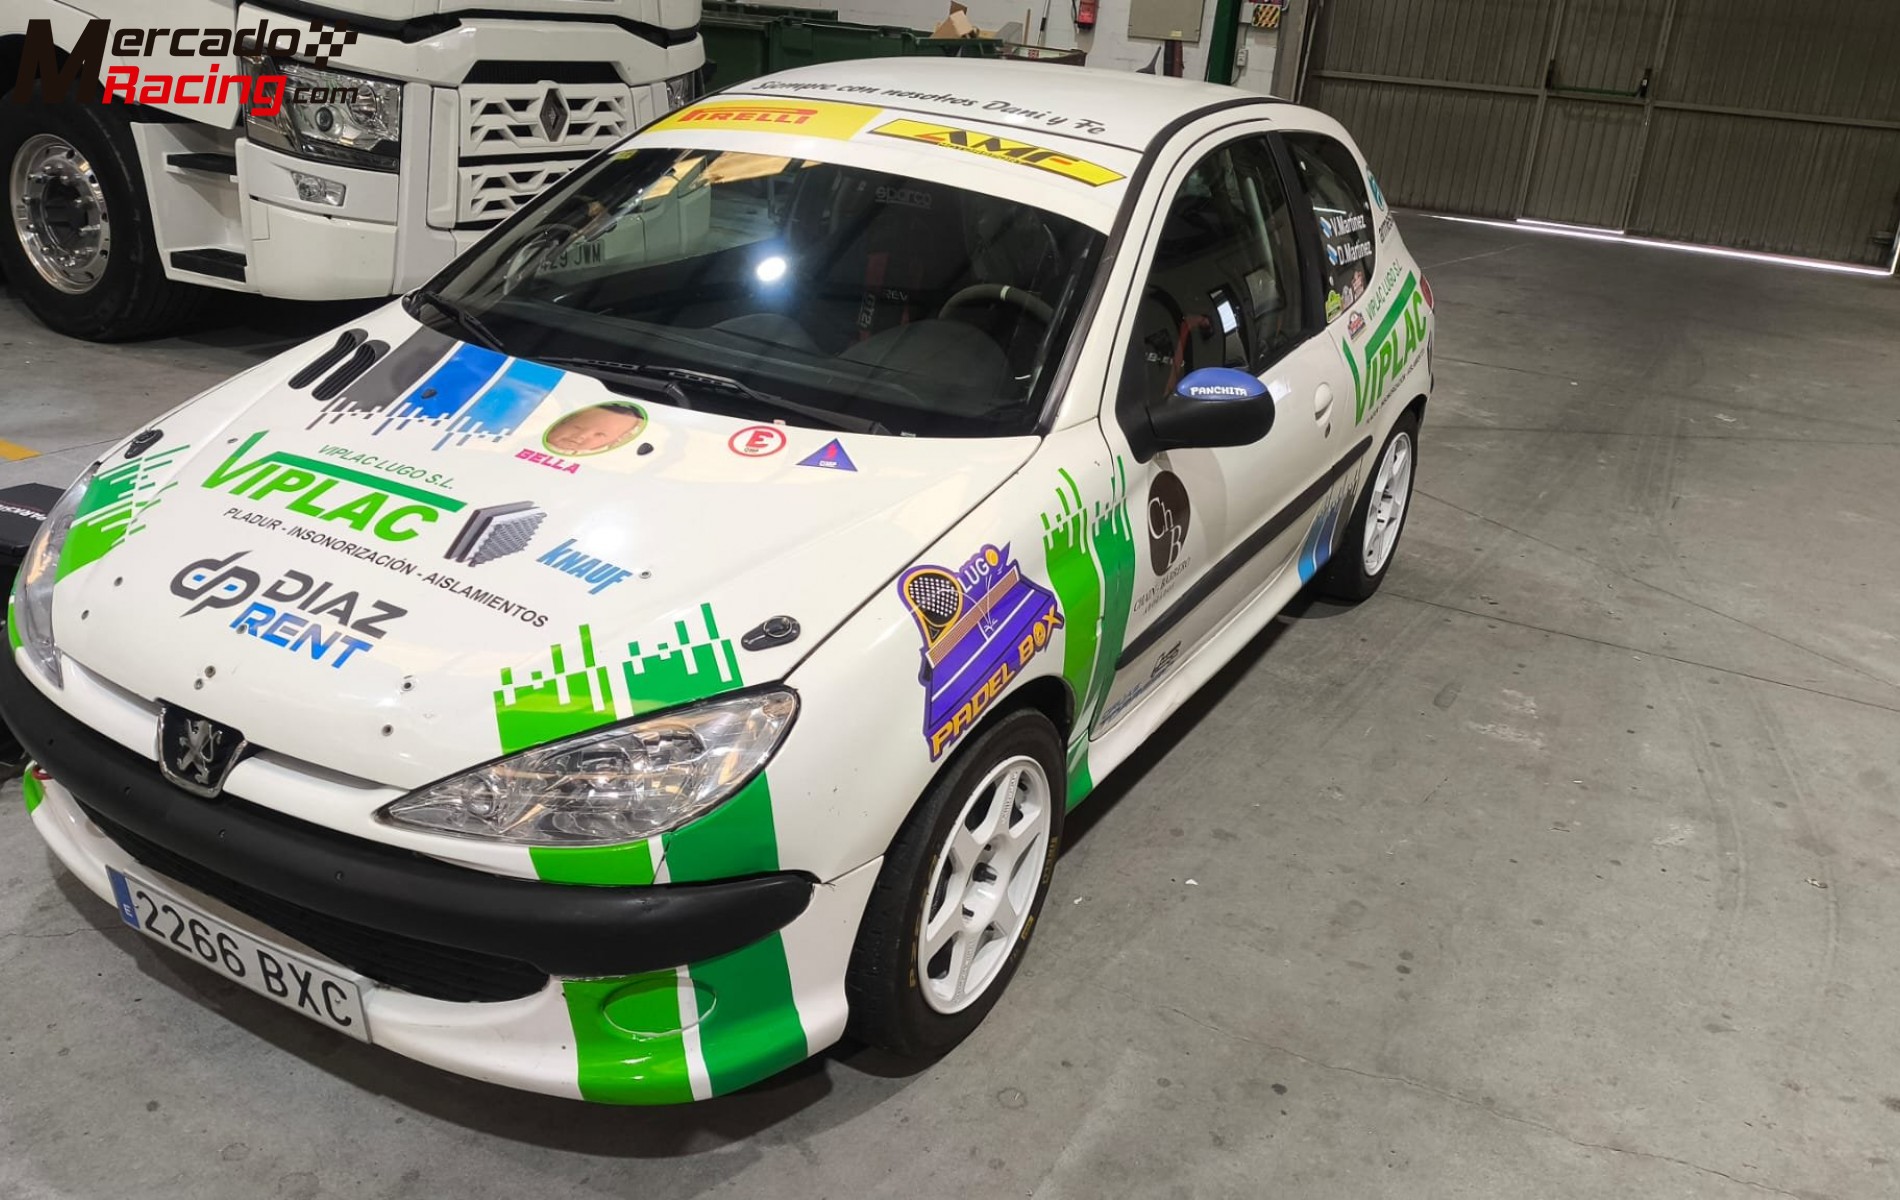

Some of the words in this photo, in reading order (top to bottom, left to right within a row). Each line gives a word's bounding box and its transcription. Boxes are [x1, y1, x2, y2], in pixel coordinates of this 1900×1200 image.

[678, 106, 819, 124] PIRELLI
[752, 81, 836, 92] Siempre
[837, 84, 880, 93] con
[881, 89, 979, 107] nosotros
[982, 100, 1052, 119] Dani
[1046, 116, 1068, 126] y
[1074, 118, 1106, 135] Fe
[914, 130, 1080, 164] AMF
[1342, 288, 1426, 427] VIPLAC
[1190, 386, 1248, 397] PANCHITA
[515, 448, 581, 474] BELLA
[745, 430, 774, 448] E
[201, 429, 468, 541] VIPLAC
[318, 444, 379, 467] VIPLAC
[374, 460, 427, 480] LUGO
[425, 472, 455, 490] S.L.
[223, 508, 282, 531] PLADUR
[287, 526, 418, 575] INSONORIZACIÓN
[422, 572, 549, 628] AISLAMIENTOS
[536, 538, 633, 595] KNAUF
[957, 548, 999, 592] LUGO
[261, 570, 408, 639] DIAZ
[229, 601, 374, 669] RENT
[931, 663, 1015, 757] PADEL
[1018, 604, 1062, 666] BOX
[136, 891, 246, 978] 2266
[257, 949, 352, 1027] BXC
